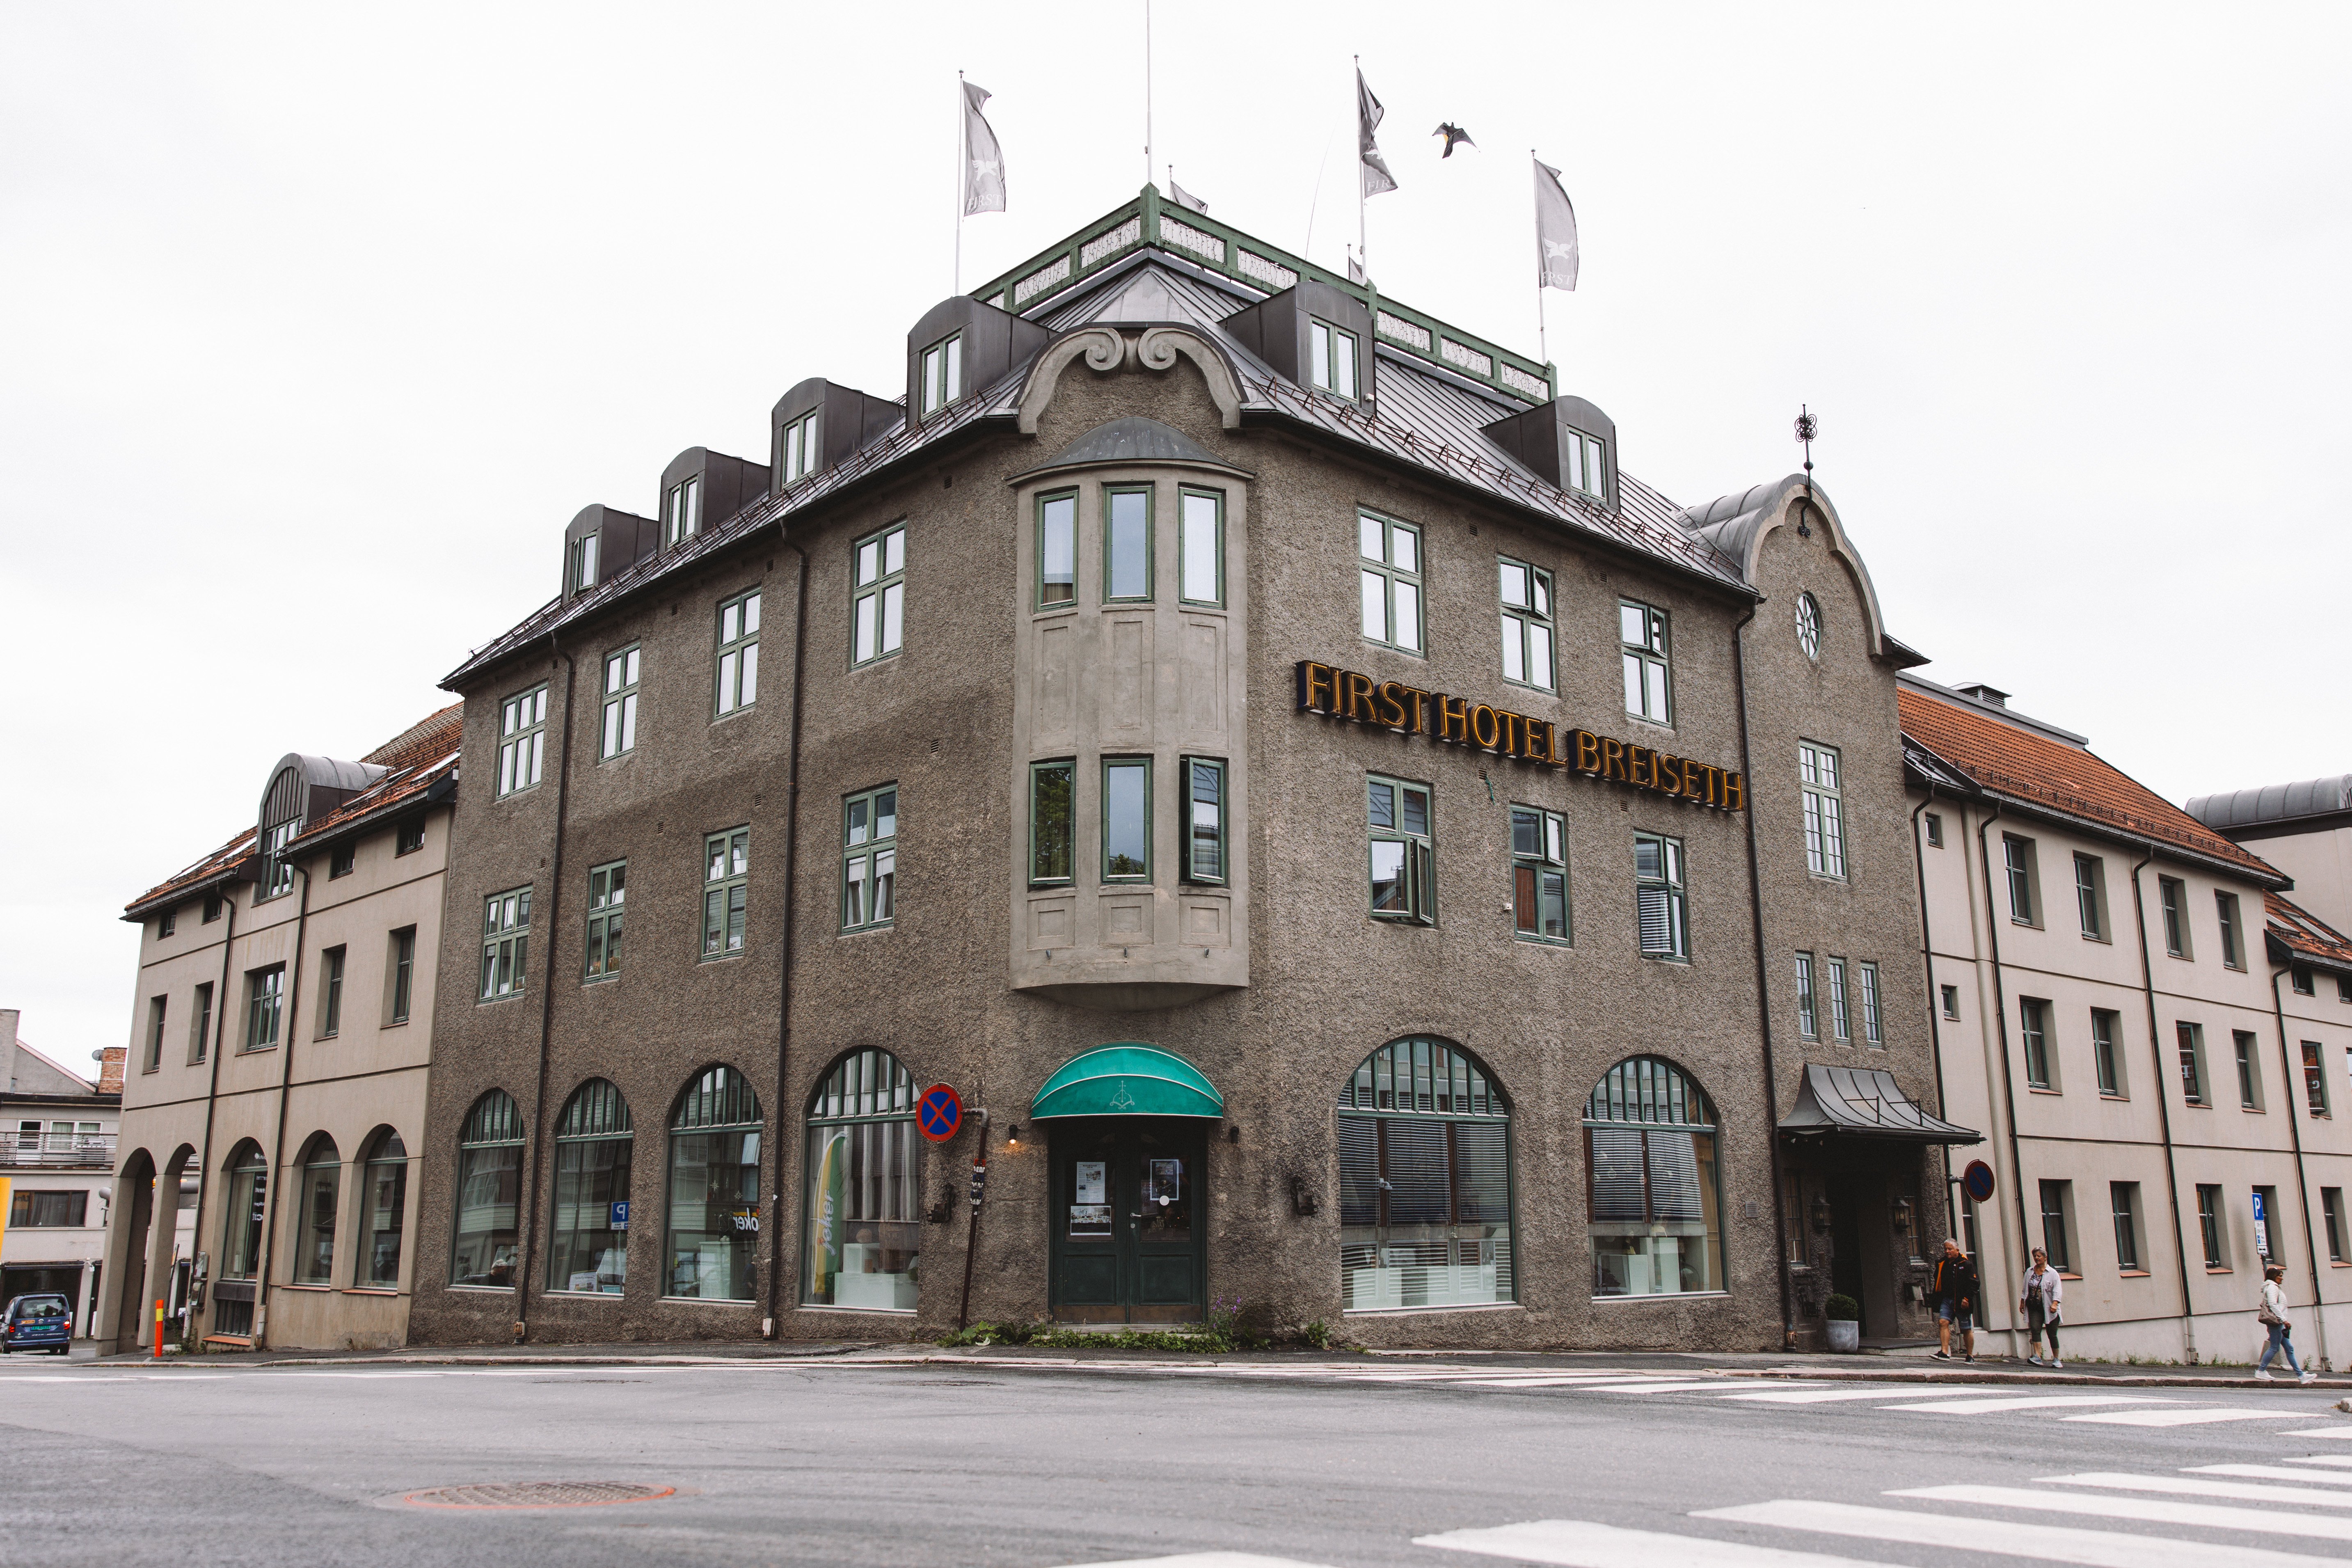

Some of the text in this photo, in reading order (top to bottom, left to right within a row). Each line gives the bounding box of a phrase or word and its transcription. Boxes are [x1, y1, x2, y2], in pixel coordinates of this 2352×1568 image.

[1367, 179, 1392, 192] FIR
[968, 194, 1003, 211] FIRST
[1296, 660, 1743, 812] FIRST HOTEL BREISETH
[2254, 1197, 2260, 1217] P
[817, 1189, 836, 1256] joker
